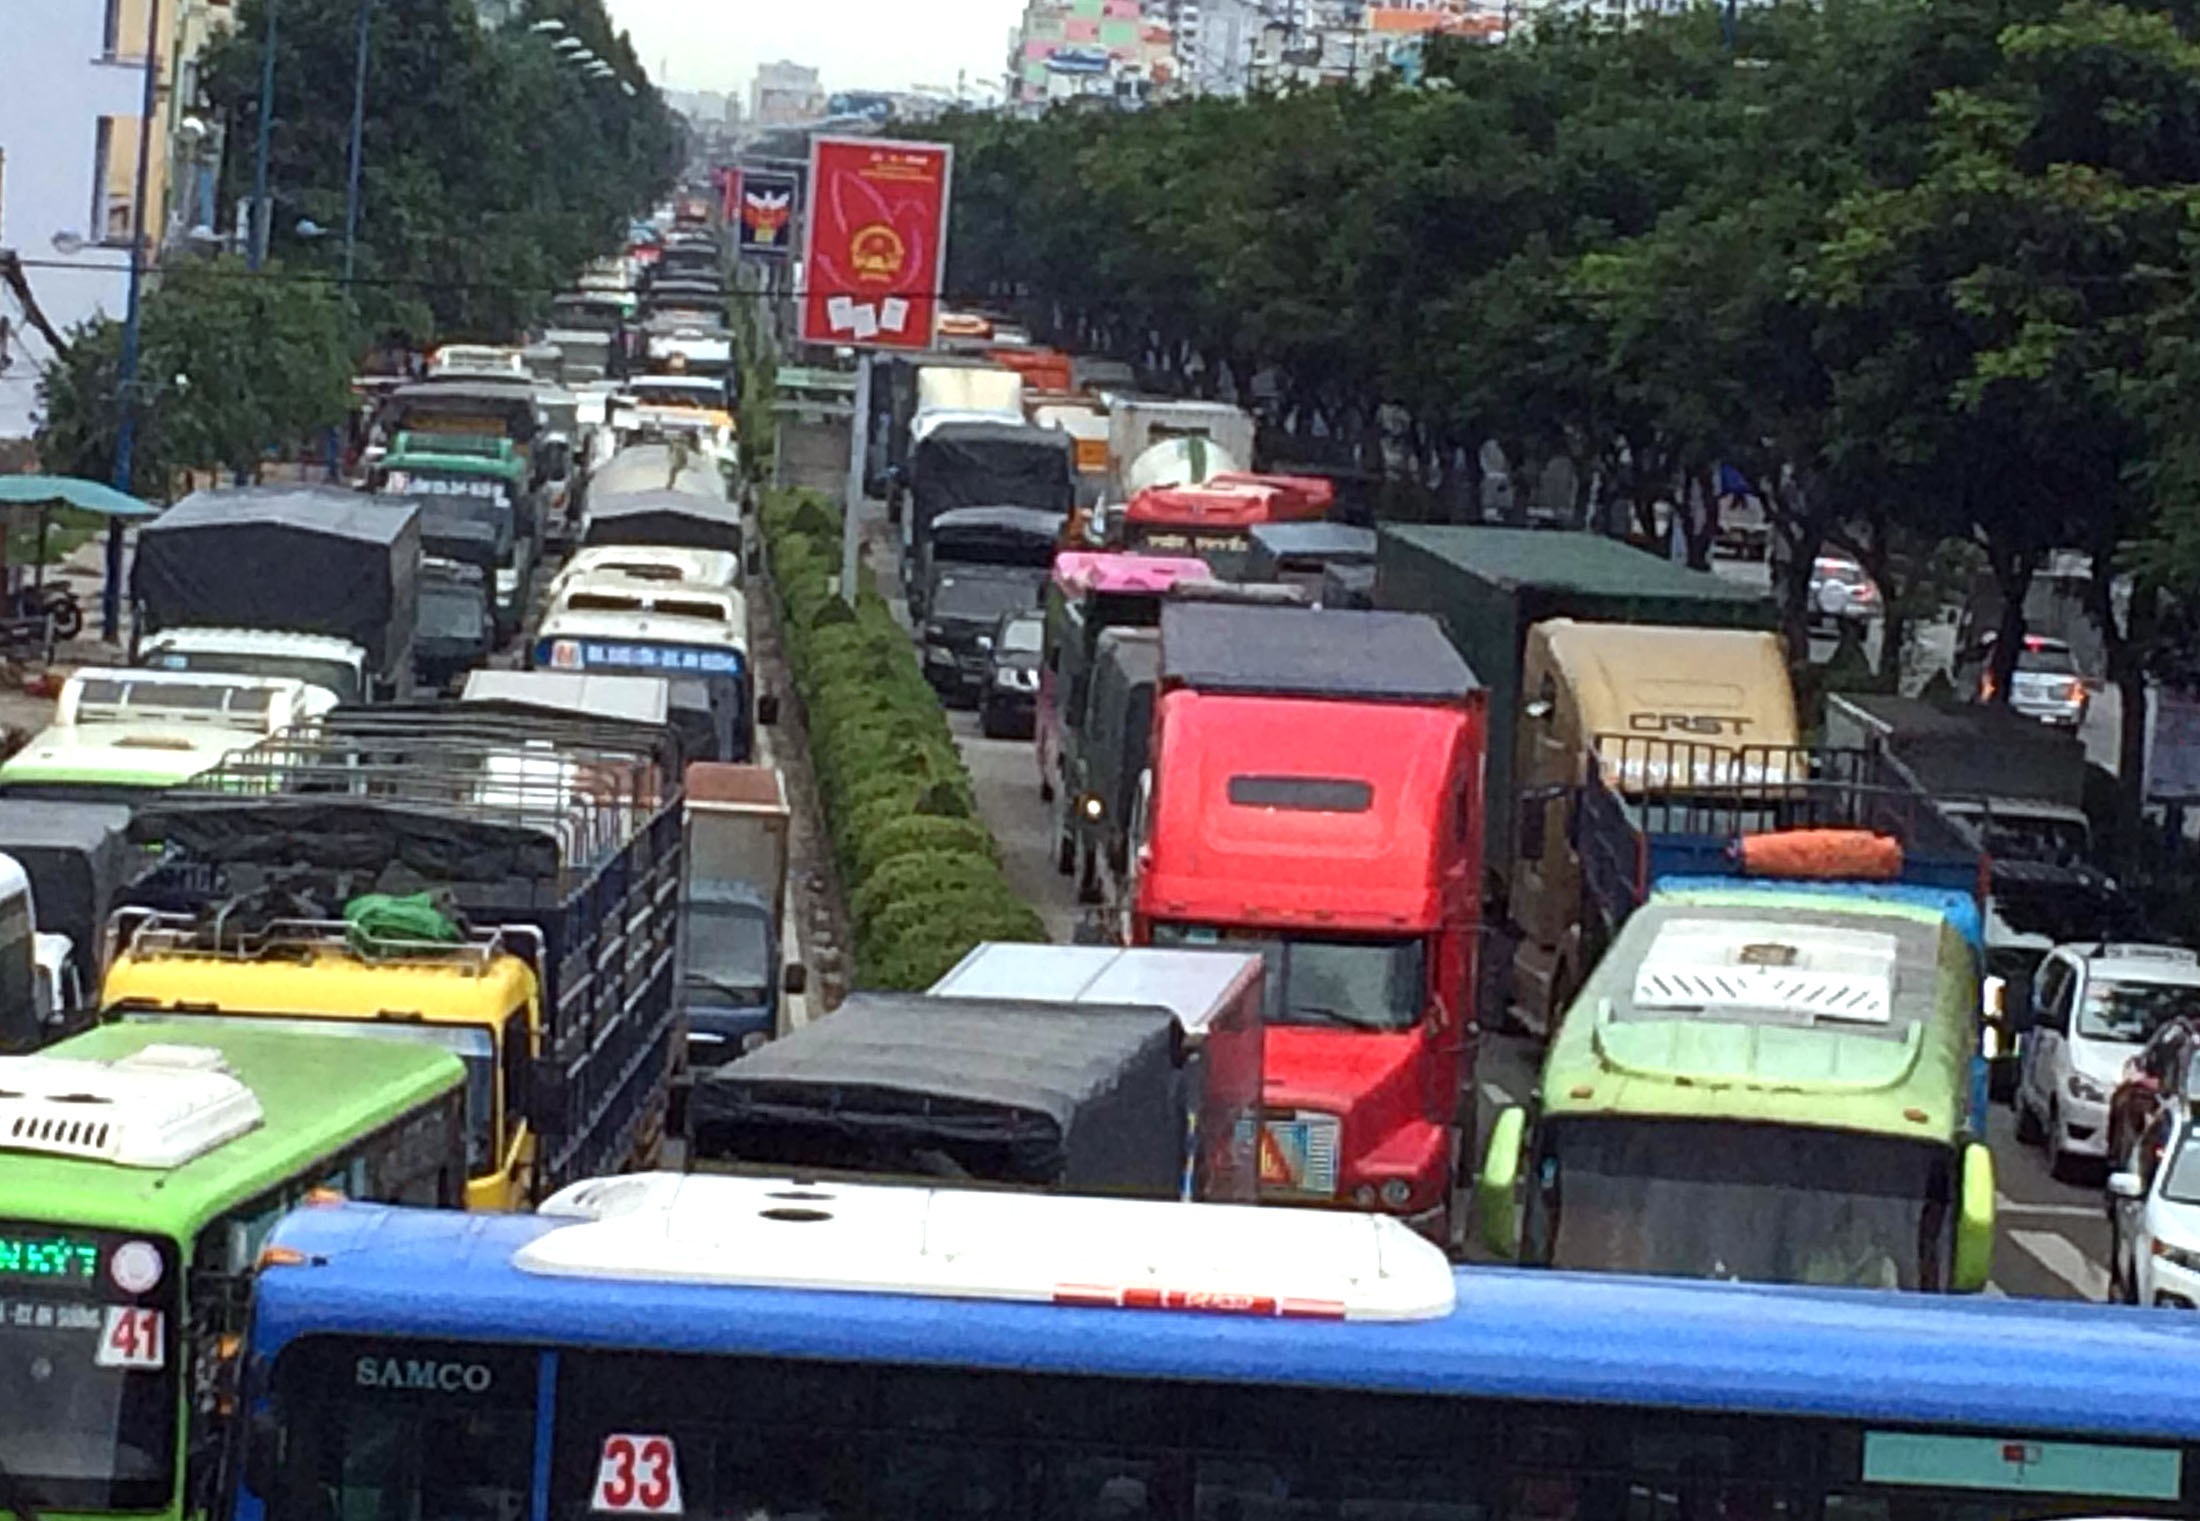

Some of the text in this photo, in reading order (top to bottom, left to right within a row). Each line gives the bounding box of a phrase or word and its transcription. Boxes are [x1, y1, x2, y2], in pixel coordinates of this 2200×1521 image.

[1629, 711, 1754, 736] CRST
[110, 1306, 158, 1361] 41
[355, 1356, 492, 1392] SAMCO
[603, 1438, 672, 1509] 33
